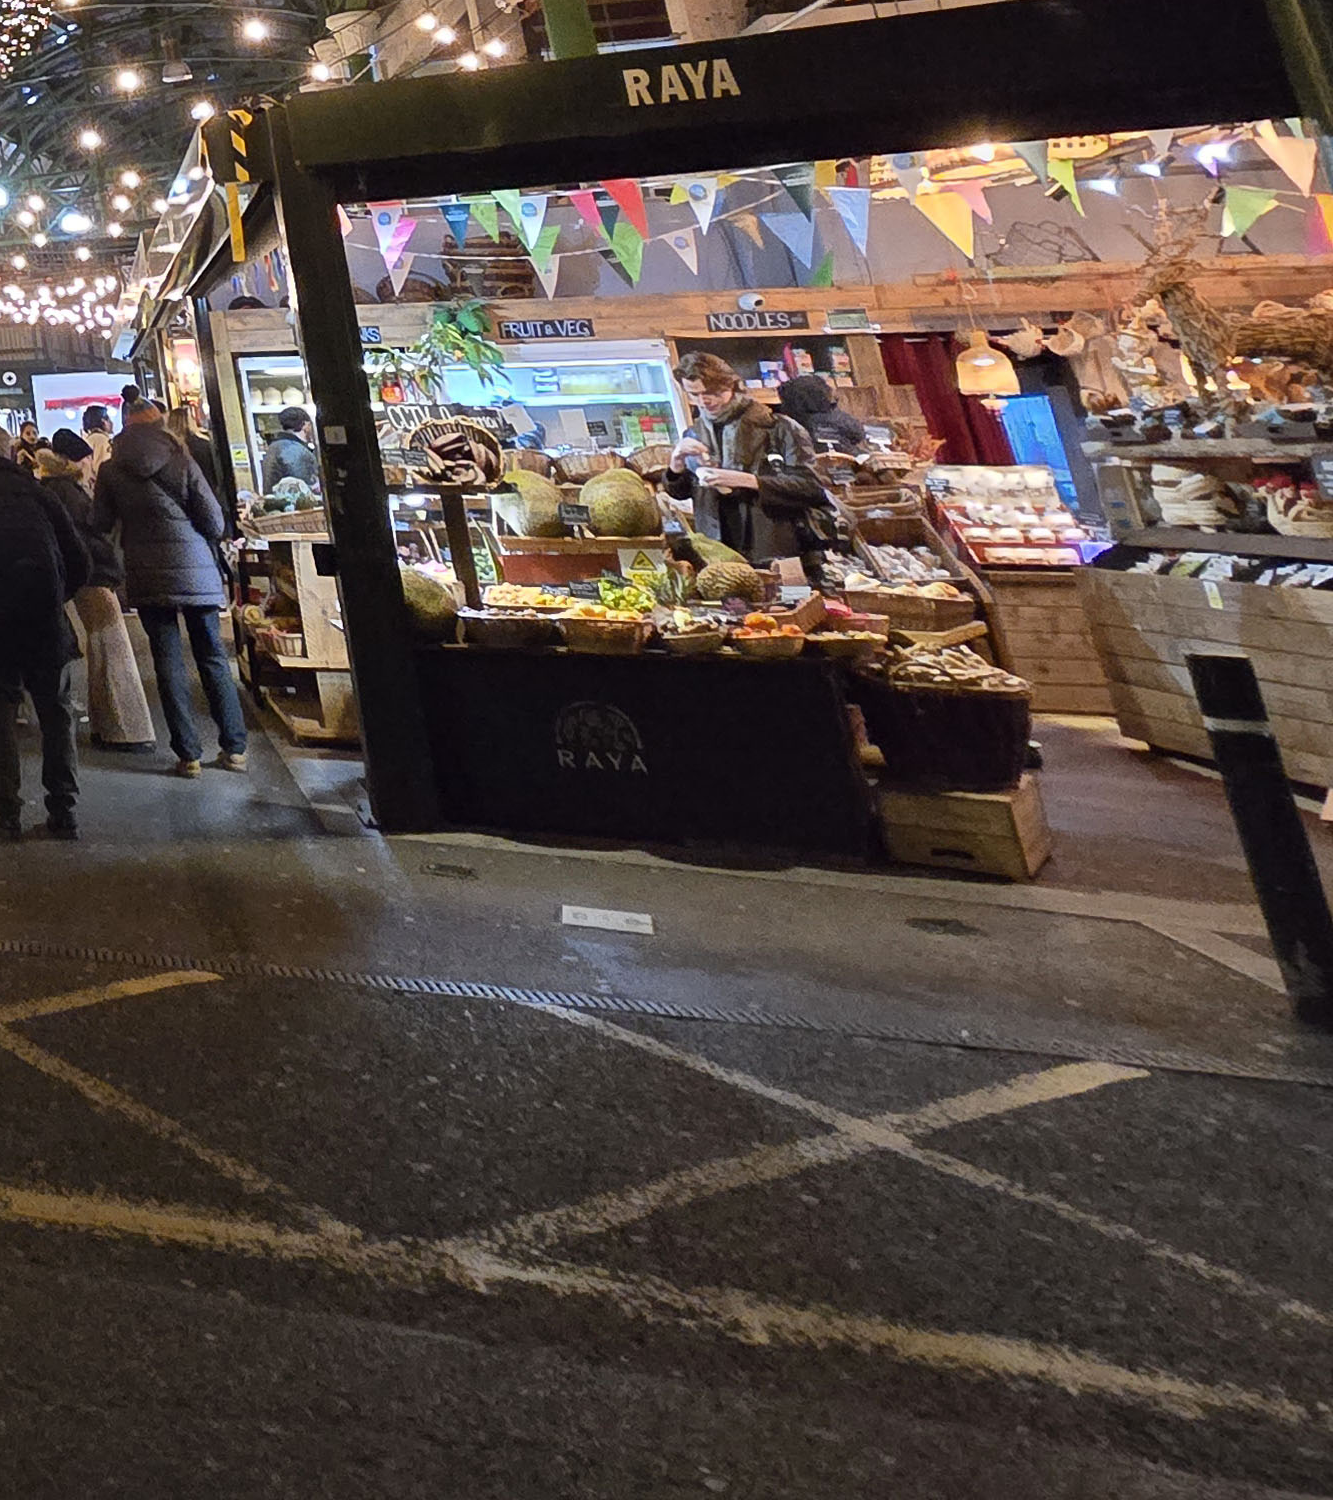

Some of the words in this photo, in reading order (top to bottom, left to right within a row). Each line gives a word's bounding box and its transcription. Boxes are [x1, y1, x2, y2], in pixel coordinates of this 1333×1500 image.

[623, 58, 741, 106] RAYA
[501, 321, 543, 338] FRUIT
[555, 320, 590, 336] VEG
[709, 313, 790, 331] NOODLES
[557, 748, 648, 775] RAYA
